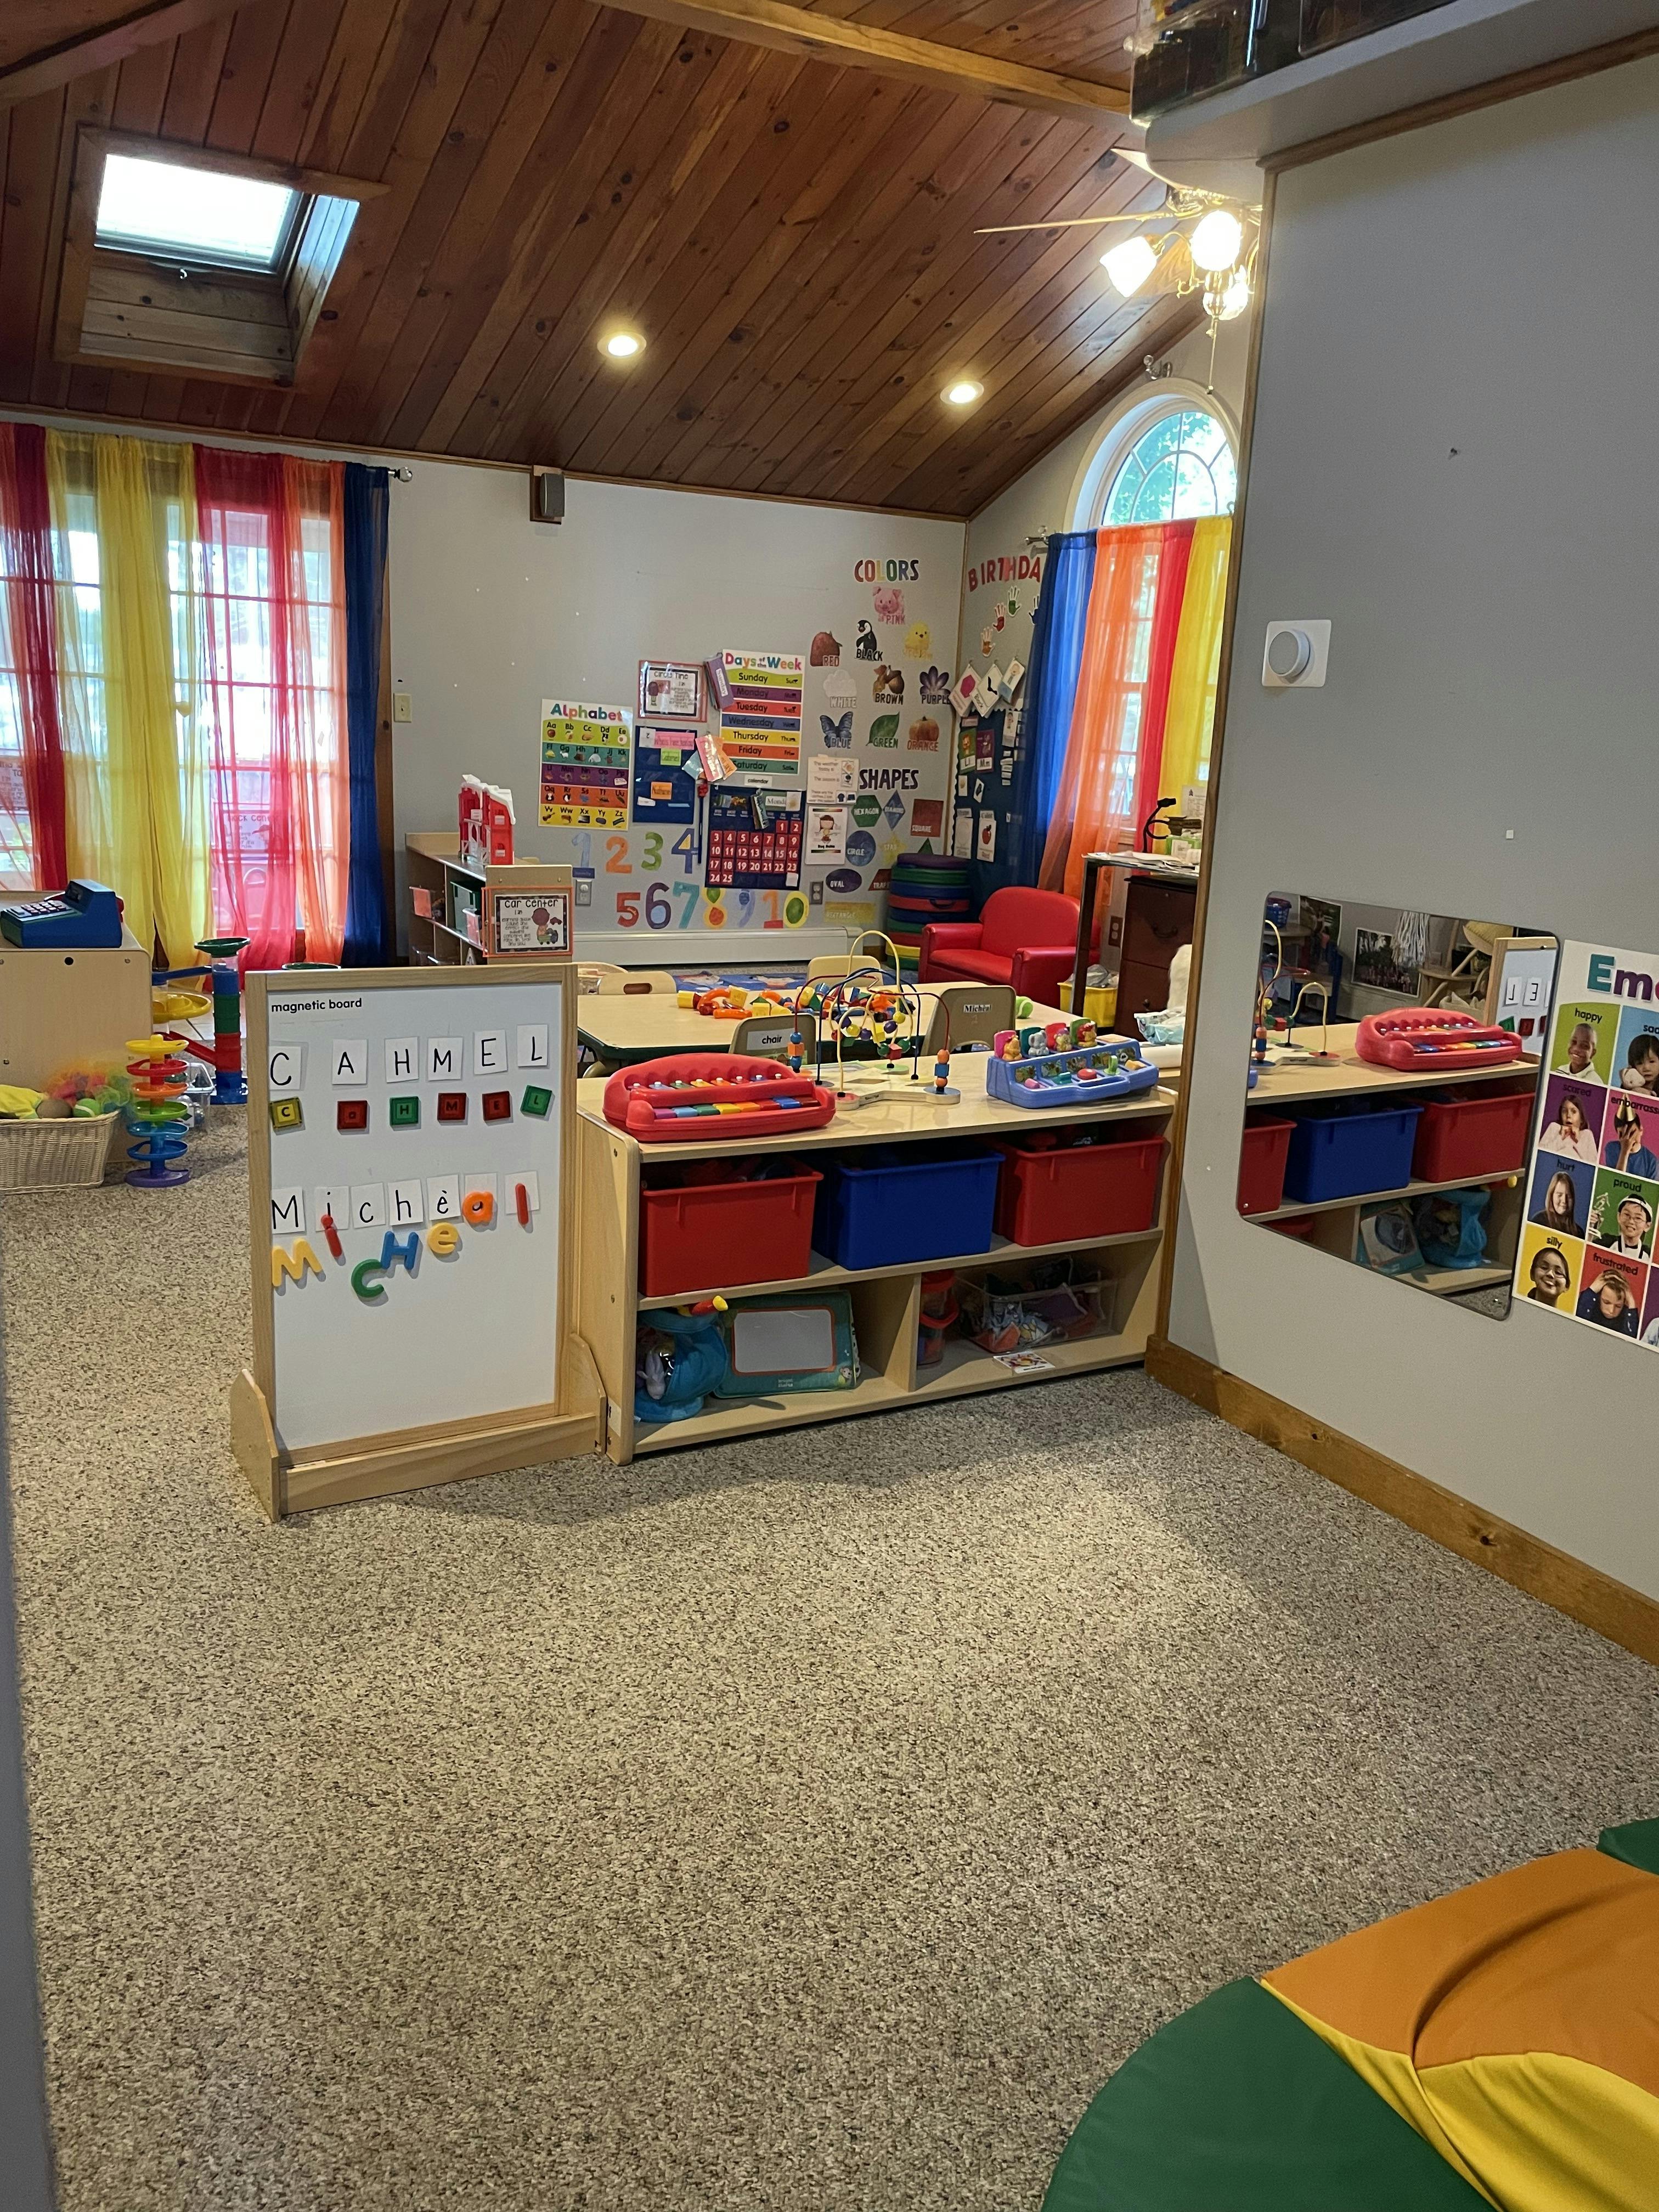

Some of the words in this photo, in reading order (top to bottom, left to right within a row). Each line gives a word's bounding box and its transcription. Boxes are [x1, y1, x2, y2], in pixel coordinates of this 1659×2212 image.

[854, 560, 919, 583] COLORS
[886, 615, 905, 625] PINK
[856, 648, 883, 661] BLACK
[725, 652, 756, 669] Days
[767, 656, 802, 670] Week
[823, 656, 839, 667] RED
[738, 672, 768, 684] Sunday
[737, 687, 769, 698] Monday
[830, 696, 856, 708] WHITE
[875, 693, 904, 705] BROWN
[922, 694, 951, 705] PURPLE
[736, 702, 768, 713] Tuesday
[728, 716, 775, 727] Wednesday
[733, 731, 769, 741] Thursday
[560, 744, 570, 753] Gg
[830, 737, 851, 749] BLUE
[873, 737, 899, 749] GREEN
[907, 740, 939, 752] ORANGE
[738, 746, 762, 757] Friday
[733, 760, 768, 771] Saturday
[859, 769, 919, 790] SHAPES
[544, 785, 555, 794] Qq
[854, 808, 879, 816] HEXAGON
[780, 823, 784, 831] 1
[794, 823, 799, 832] 2
[912, 825, 932, 833] SQUARE
[714, 833, 719, 842] 3
[727, 833, 732, 842] 4
[741, 834, 746, 842] 5
[753, 836, 759, 844] 6
[766, 836, 772, 844] 7
[779, 837, 785, 845] 8
[792, 837, 797, 845] 9
[572, 832, 595, 878] 1
[605, 836, 633, 874] 2
[641, 831, 664, 871] 3
[671, 827, 698, 874] 4
[712, 847, 720, 855] 10
[725, 847, 734, 855] 11
[738, 848, 747, 857] 12
[751, 849, 760, 857] 13
[776, 850, 785, 859] 15
[788, 850, 798, 859] 16
[710, 860, 719, 868] 17
[724, 861, 732, 870] 18
[737, 862, 747, 870] 19
[750, 862, 760, 871] 20
[763, 863, 772, 871] 21
[787, 863, 797, 871] 23
[710, 874, 720, 882] 24
[722, 874, 733, 883] 25
[525, 899, 558, 907] center
[617, 892, 641, 928] 5
[645, 882, 672, 929] 6
[672, 881, 700, 929] 7
[702, 887, 728, 929] 8
[738, 889, 755, 928] 9
[762, 890, 810, 929] 10
[1587, 953, 1659, 1003] Em
[272, 1000, 326, 1014] magnetic
[329, 997, 362, 1009] board
[1575, 1008, 1603, 1024] happy
[761, 1035, 782, 1045] chair
[1562, 1083, 1591, 1097] scared
[1557, 1158, 1575, 1172] hurt
[1613, 1178, 1642, 1193] proud
[1547, 1236, 1563, 1250] silly
[1593, 1252, 1639, 1276] frustrated
